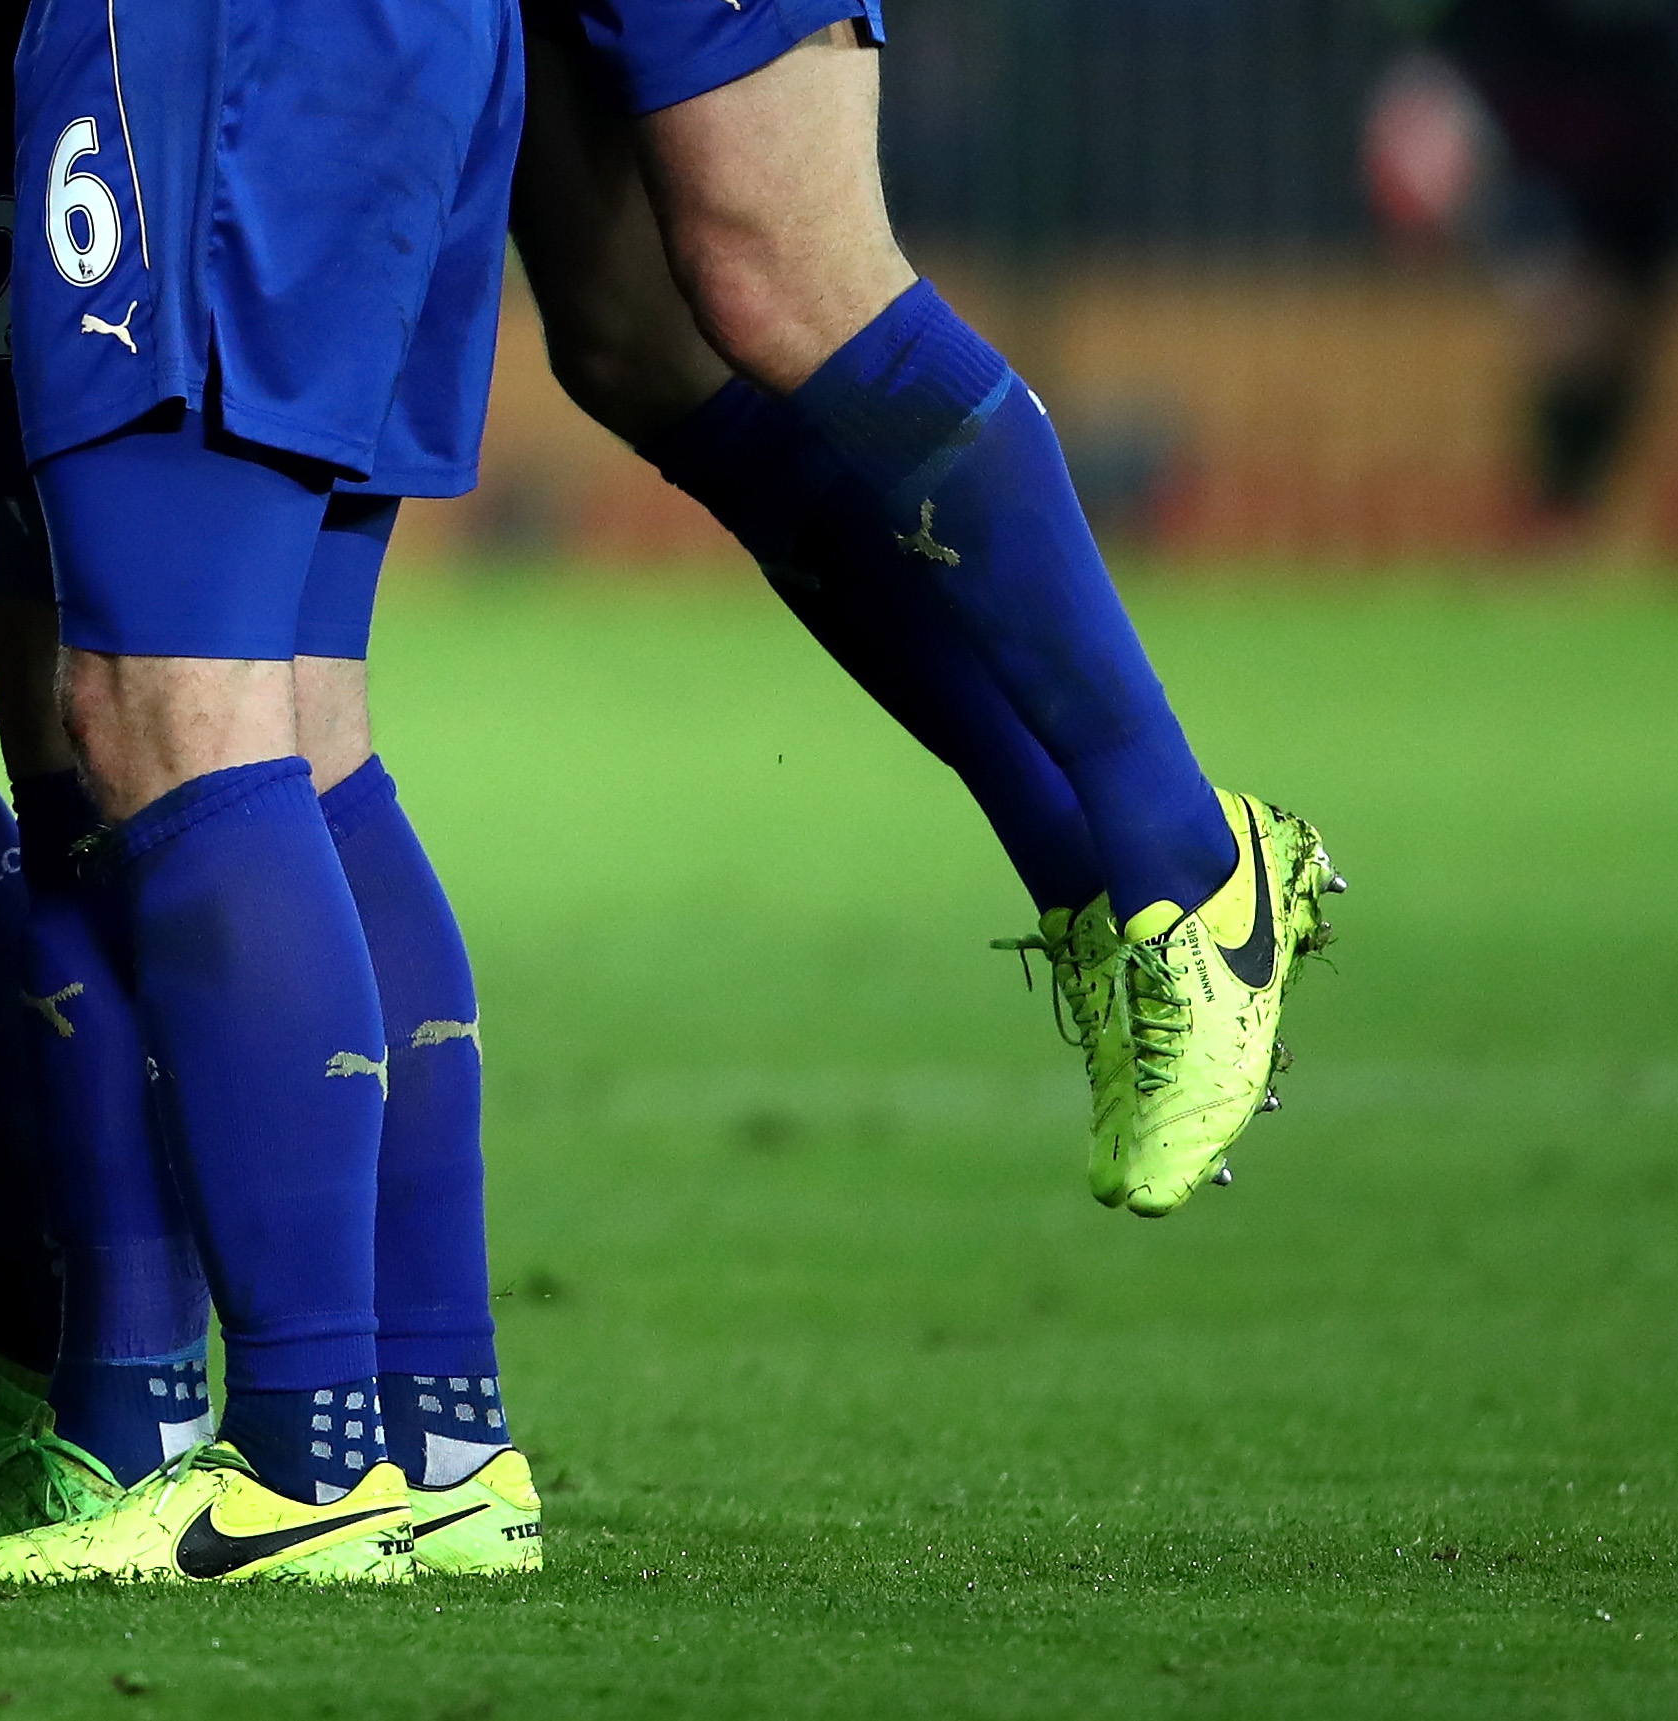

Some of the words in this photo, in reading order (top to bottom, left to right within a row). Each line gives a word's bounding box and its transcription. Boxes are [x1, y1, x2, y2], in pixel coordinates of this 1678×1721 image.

[47, 116, 122, 287] 6
[1186, 921, 1203, 957] BABIES
[1194, 958, 1216, 1003] NANNIES
